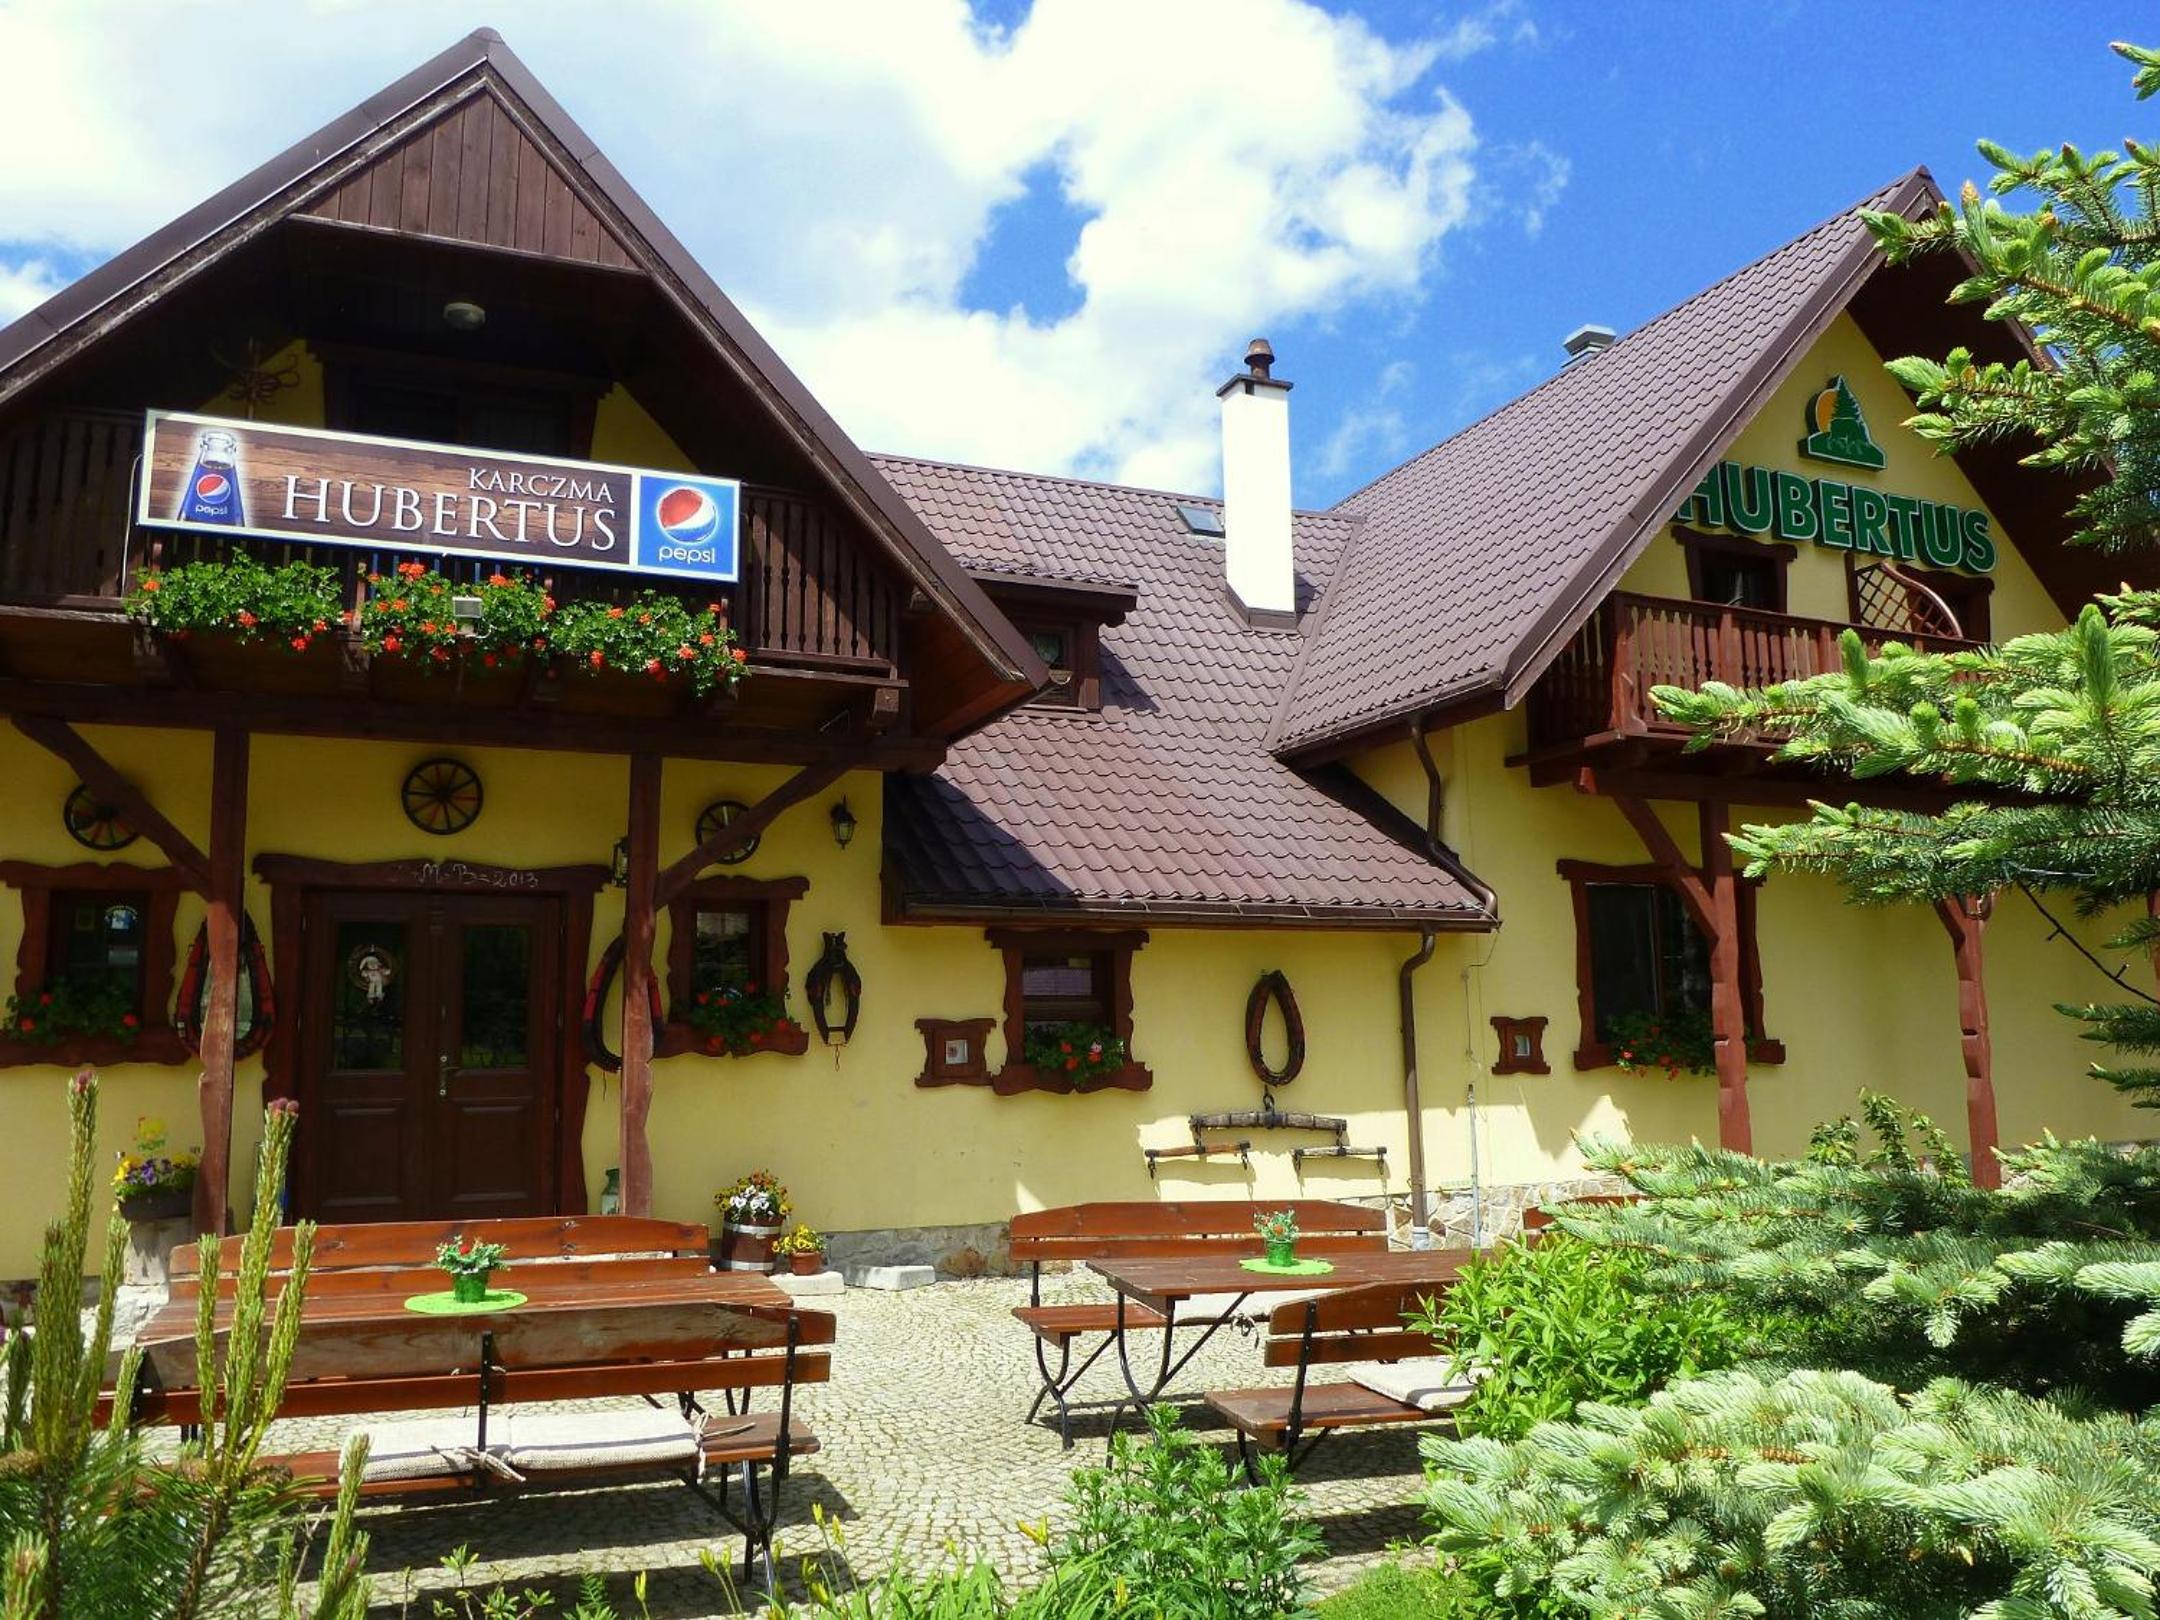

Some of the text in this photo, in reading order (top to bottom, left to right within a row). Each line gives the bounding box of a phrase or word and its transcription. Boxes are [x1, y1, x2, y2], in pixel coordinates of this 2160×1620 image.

[468, 467, 615, 504] KARCZMA
[195, 504, 228, 517] pepsi
[281, 474, 616, 551] HUBERTUS
[1675, 460, 1997, 573] HUBERTUS
[658, 546, 716, 565] pepsi
